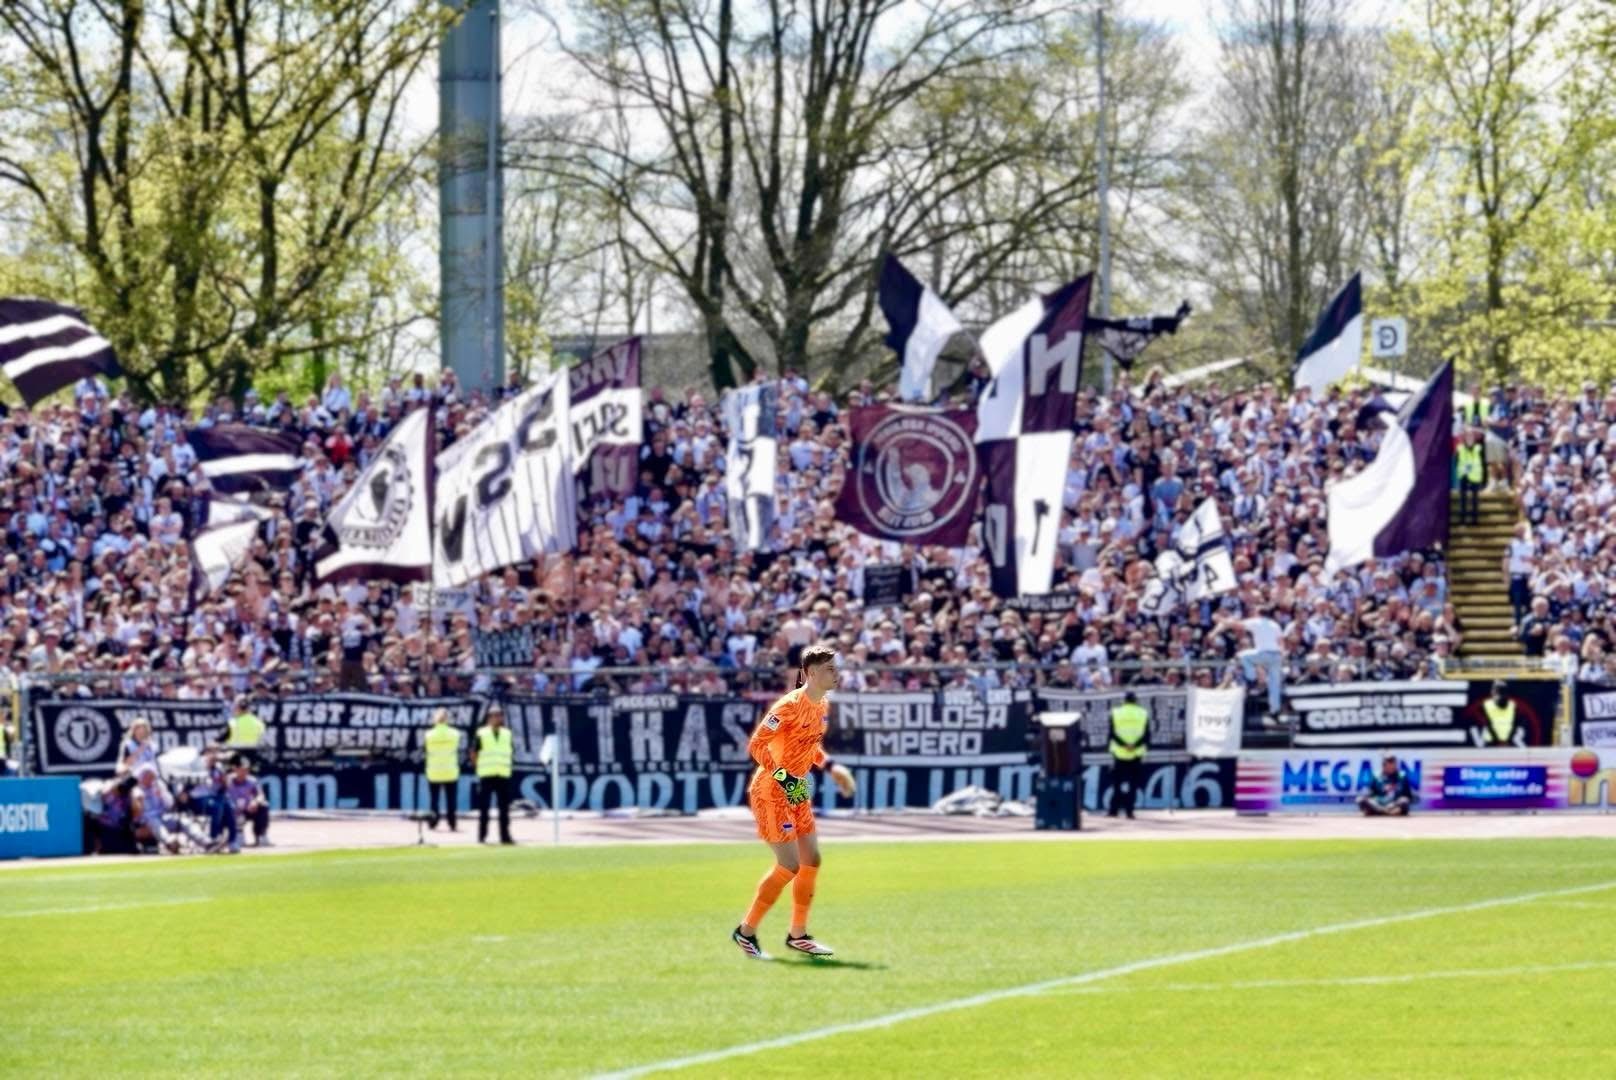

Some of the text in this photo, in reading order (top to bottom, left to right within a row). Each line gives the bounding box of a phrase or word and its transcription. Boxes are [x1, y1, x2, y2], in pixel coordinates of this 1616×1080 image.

[281, 703, 345, 724] FEST
[350, 705, 474, 727] ZUSAMEN
[839, 702, 1008, 729] NEBULOSA
[1306, 705, 1454, 730] constante
[285, 727, 410, 750] UNSEREN
[864, 731, 983, 756] IMPERO
